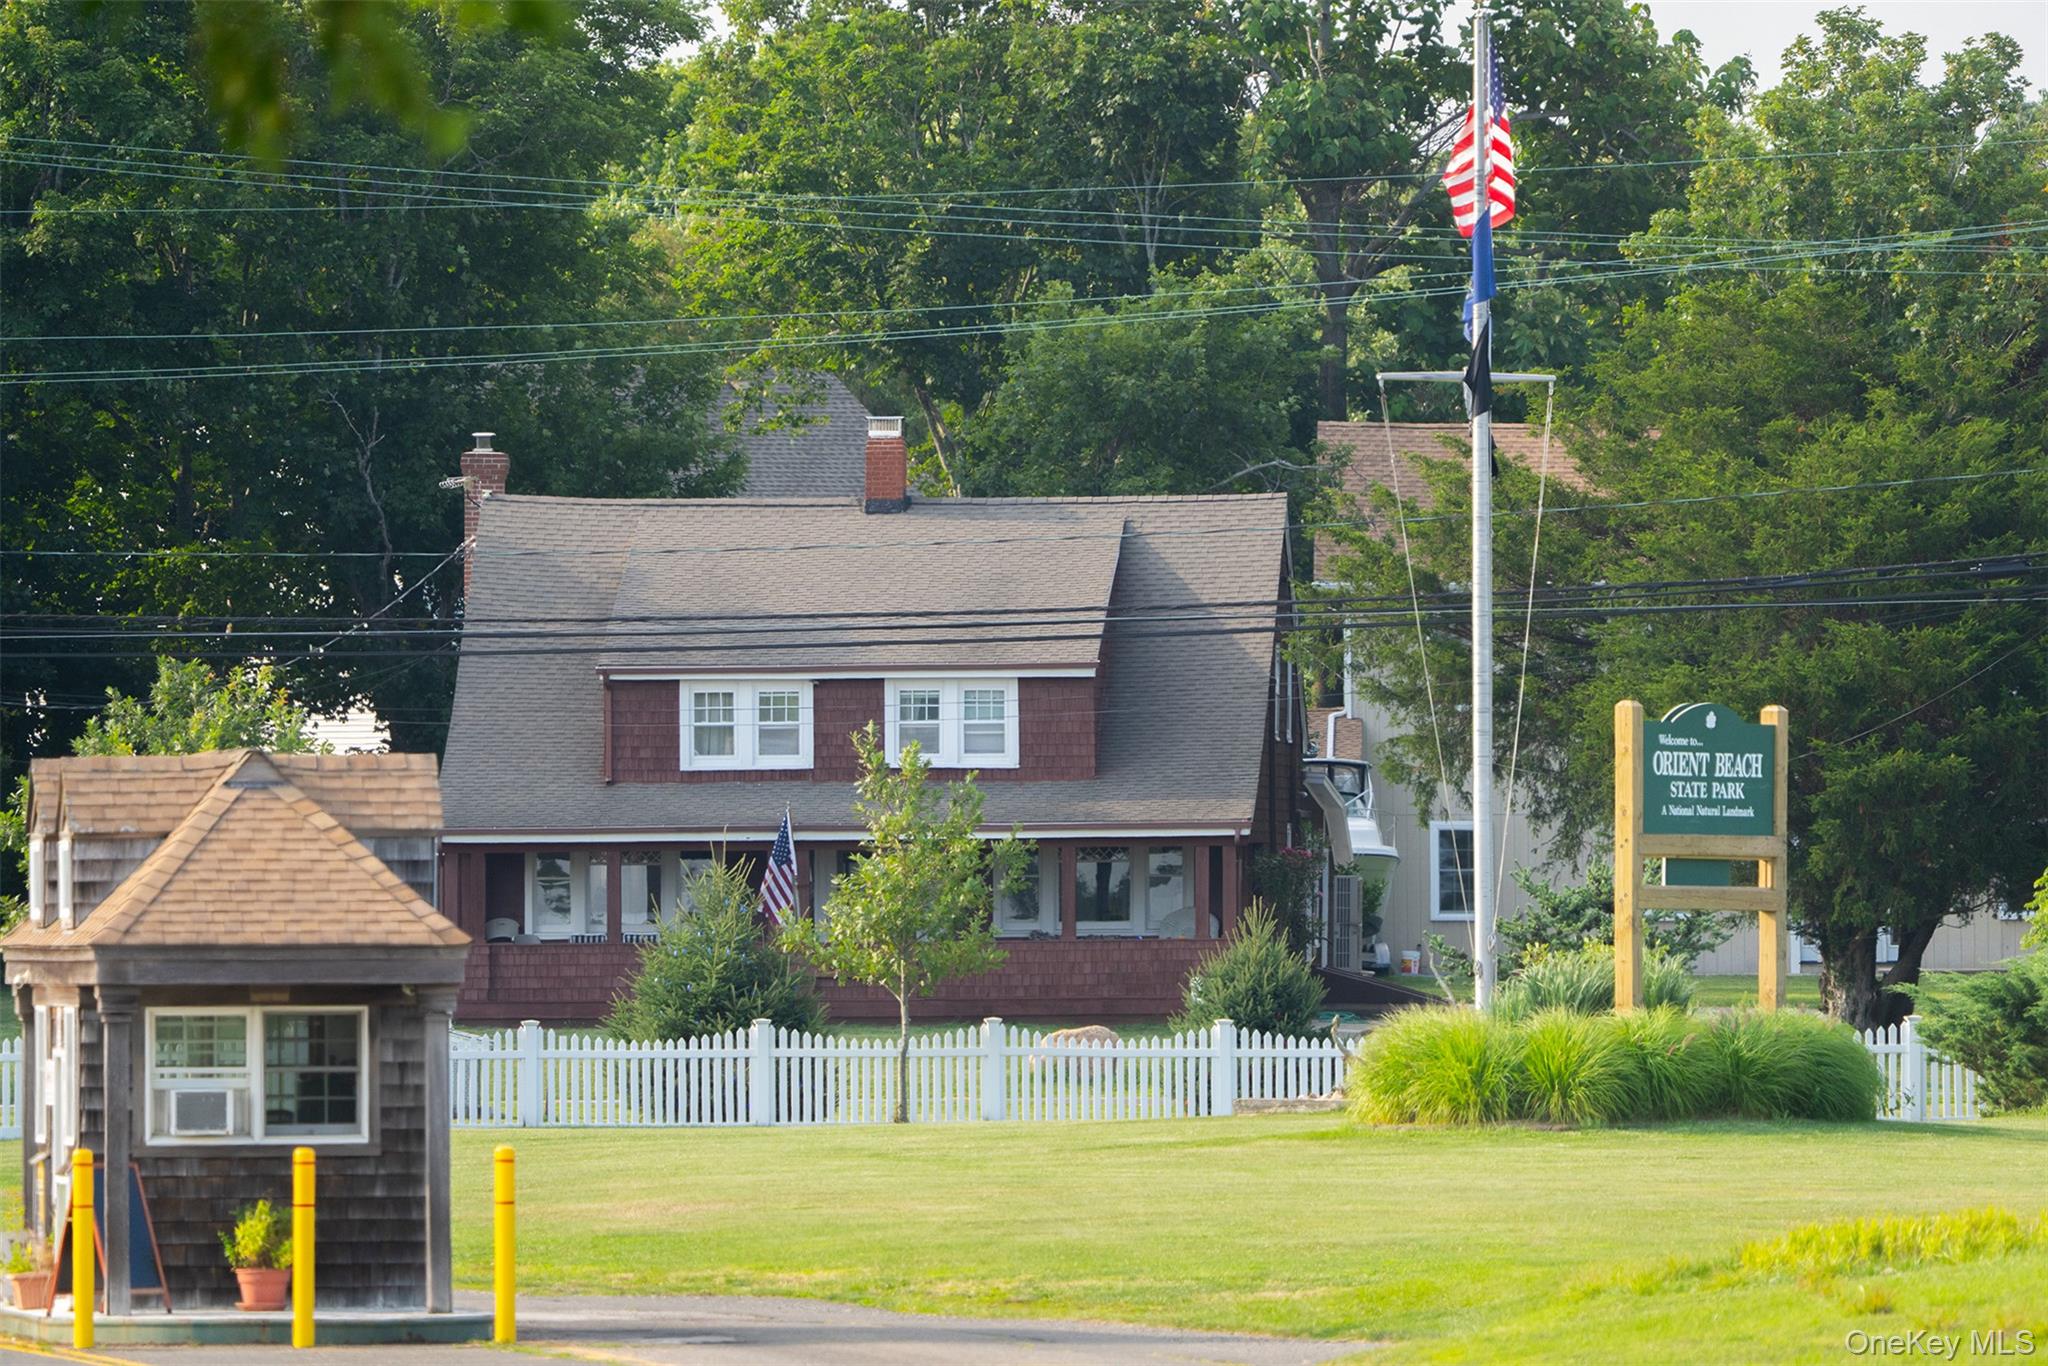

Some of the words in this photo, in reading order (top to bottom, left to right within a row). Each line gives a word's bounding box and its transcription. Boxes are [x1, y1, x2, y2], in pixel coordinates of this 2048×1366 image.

[1659, 734, 1689, 746] Welcome
[1653, 751, 1710, 777] ORIENT
[1714, 753, 1763, 778] BEACH
[1670, 781, 1708, 798] STATE
[1712, 782, 1745, 799] PARK
[1661, 805, 1667, 816] A
[1668, 804, 1695, 816] National
[1696, 805, 1721, 816] Natural
[1722, 806, 1755, 817] Landmark
